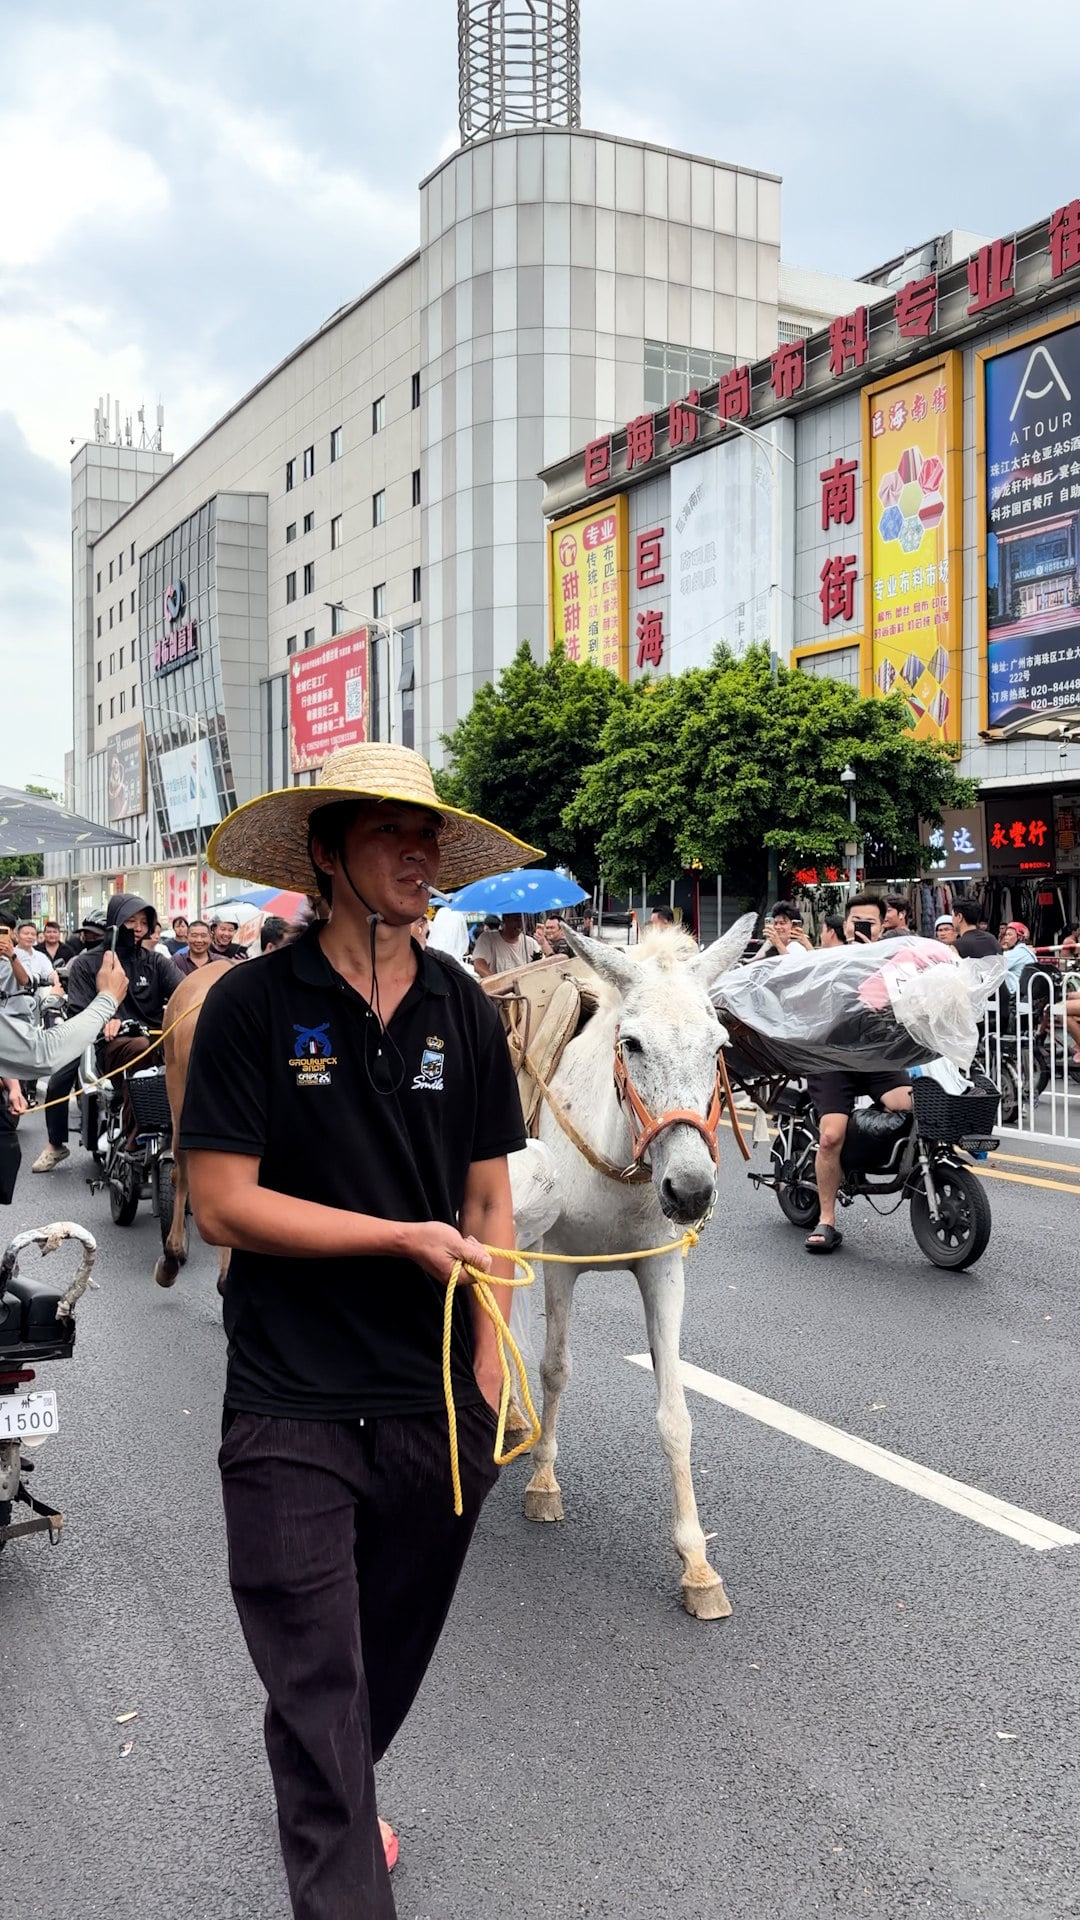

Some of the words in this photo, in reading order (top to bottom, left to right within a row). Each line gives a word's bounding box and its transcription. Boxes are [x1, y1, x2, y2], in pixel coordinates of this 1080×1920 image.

[871, 385, 948, 439] 巨海南街
[1009, 412, 1073, 446] ATOUR
[586, 520, 615, 546] 专业
[819, 458, 858, 626] 南街
[636, 528, 665, 669] 巨海
[874, 559, 949, 601] 专业布料市场
[562, 570, 582, 662] 甜甜洗
[1009, 671, 1031, 684] 222号
[990, 820, 1048, 849] 永豐行
[4, 1411, 53, 1432] 1500
